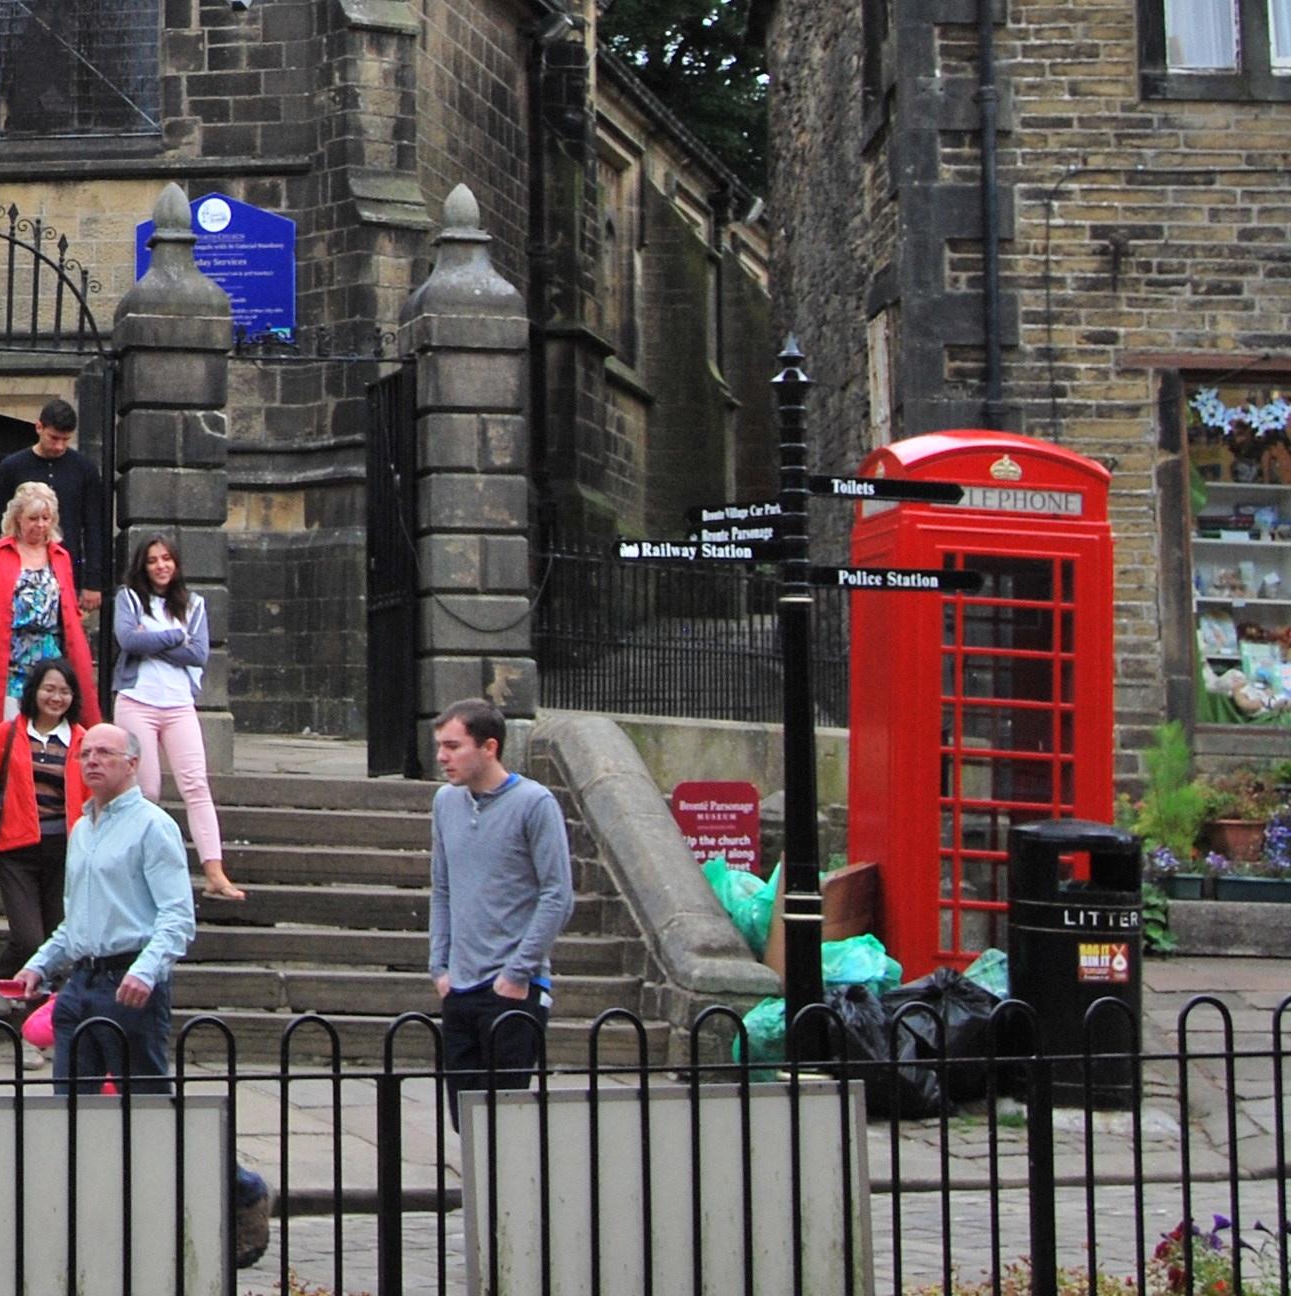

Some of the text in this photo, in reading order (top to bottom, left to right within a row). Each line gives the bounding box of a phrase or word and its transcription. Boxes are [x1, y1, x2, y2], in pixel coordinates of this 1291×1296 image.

[831, 479, 875, 495] Toilets
[969, 489, 1077, 513] LEPHONE
[750, 504, 764, 517] Car
[764, 503, 781, 516] Park
[731, 526, 774, 542] Parsonage
[641, 542, 752, 560] Railway Station
[838, 570, 939, 588] Police Station
[710, 800, 754, 814] Parsonage
[698, 835, 716, 846] the
[718, 834, 751, 846] church
[728, 848, 755, 861] along
[1064, 910, 1138, 927] LITTER
